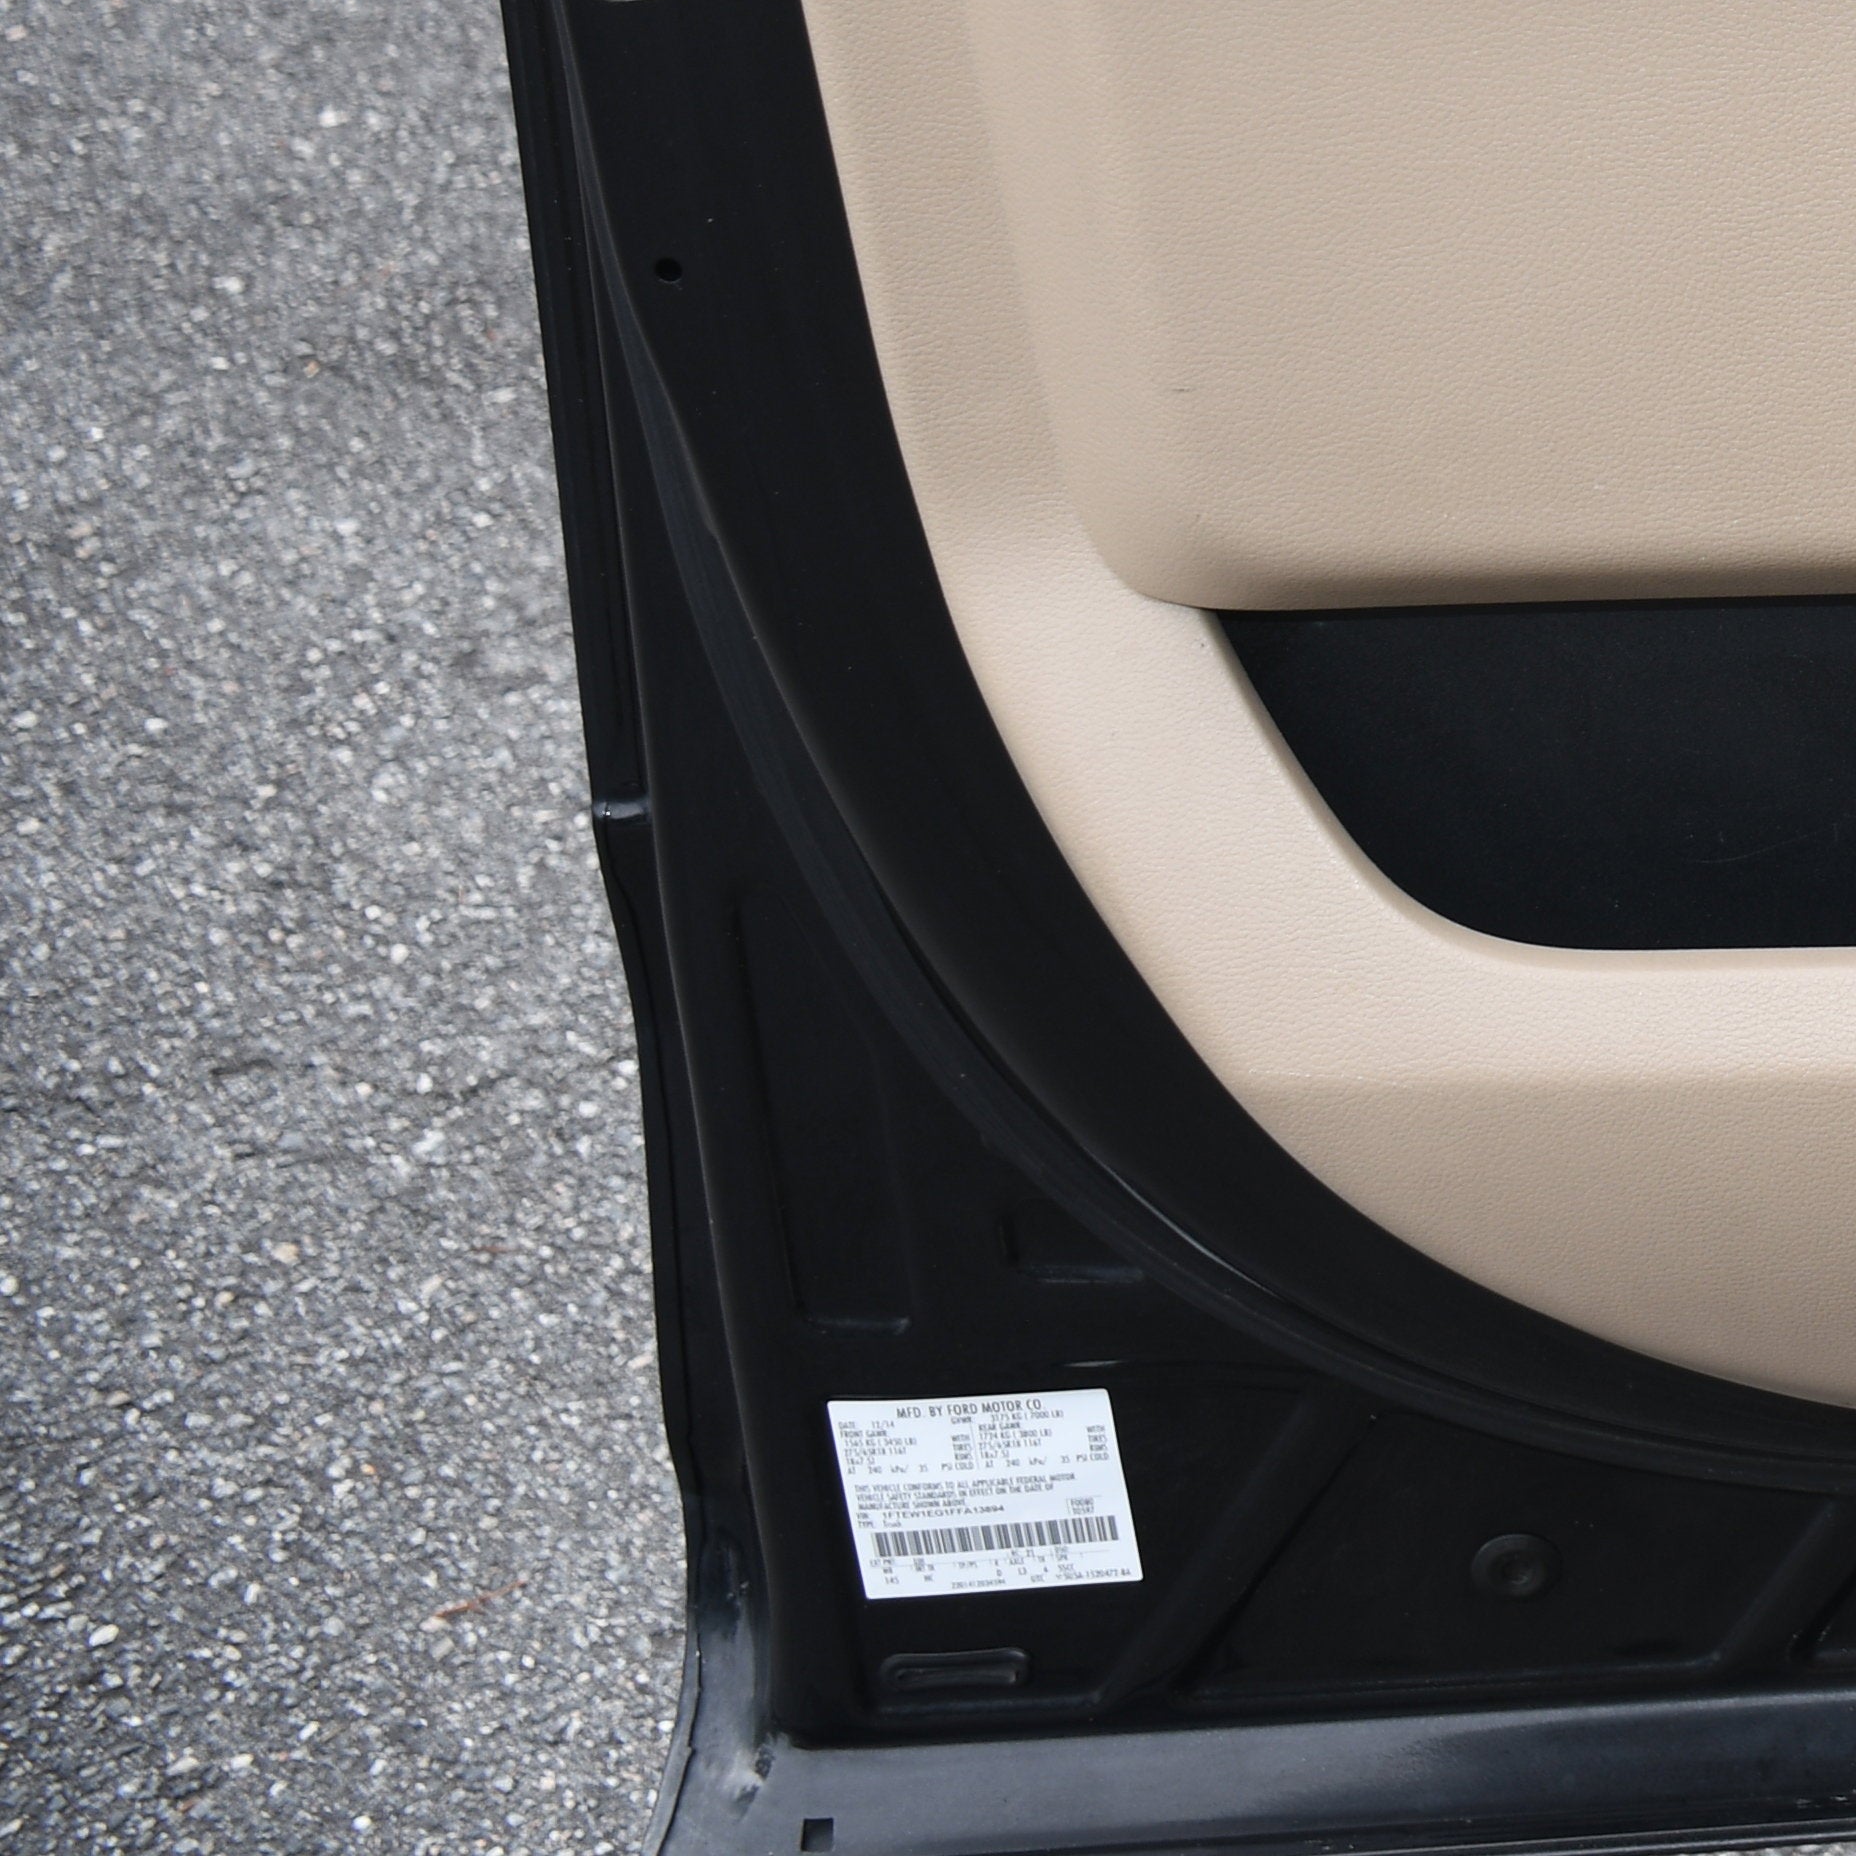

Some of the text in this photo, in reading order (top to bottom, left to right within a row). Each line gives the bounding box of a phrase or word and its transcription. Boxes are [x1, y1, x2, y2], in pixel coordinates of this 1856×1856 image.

[929, 1406, 943, 1417] BY
[947, 1404, 978, 1416] FORD
[982, 1400, 1022, 1413] MOTOR
[840, 1430, 863, 1438] FRONT
[1016, 1476, 1046, 1484] FEDERAL
[1024, 1484, 1042, 1492] DATE
